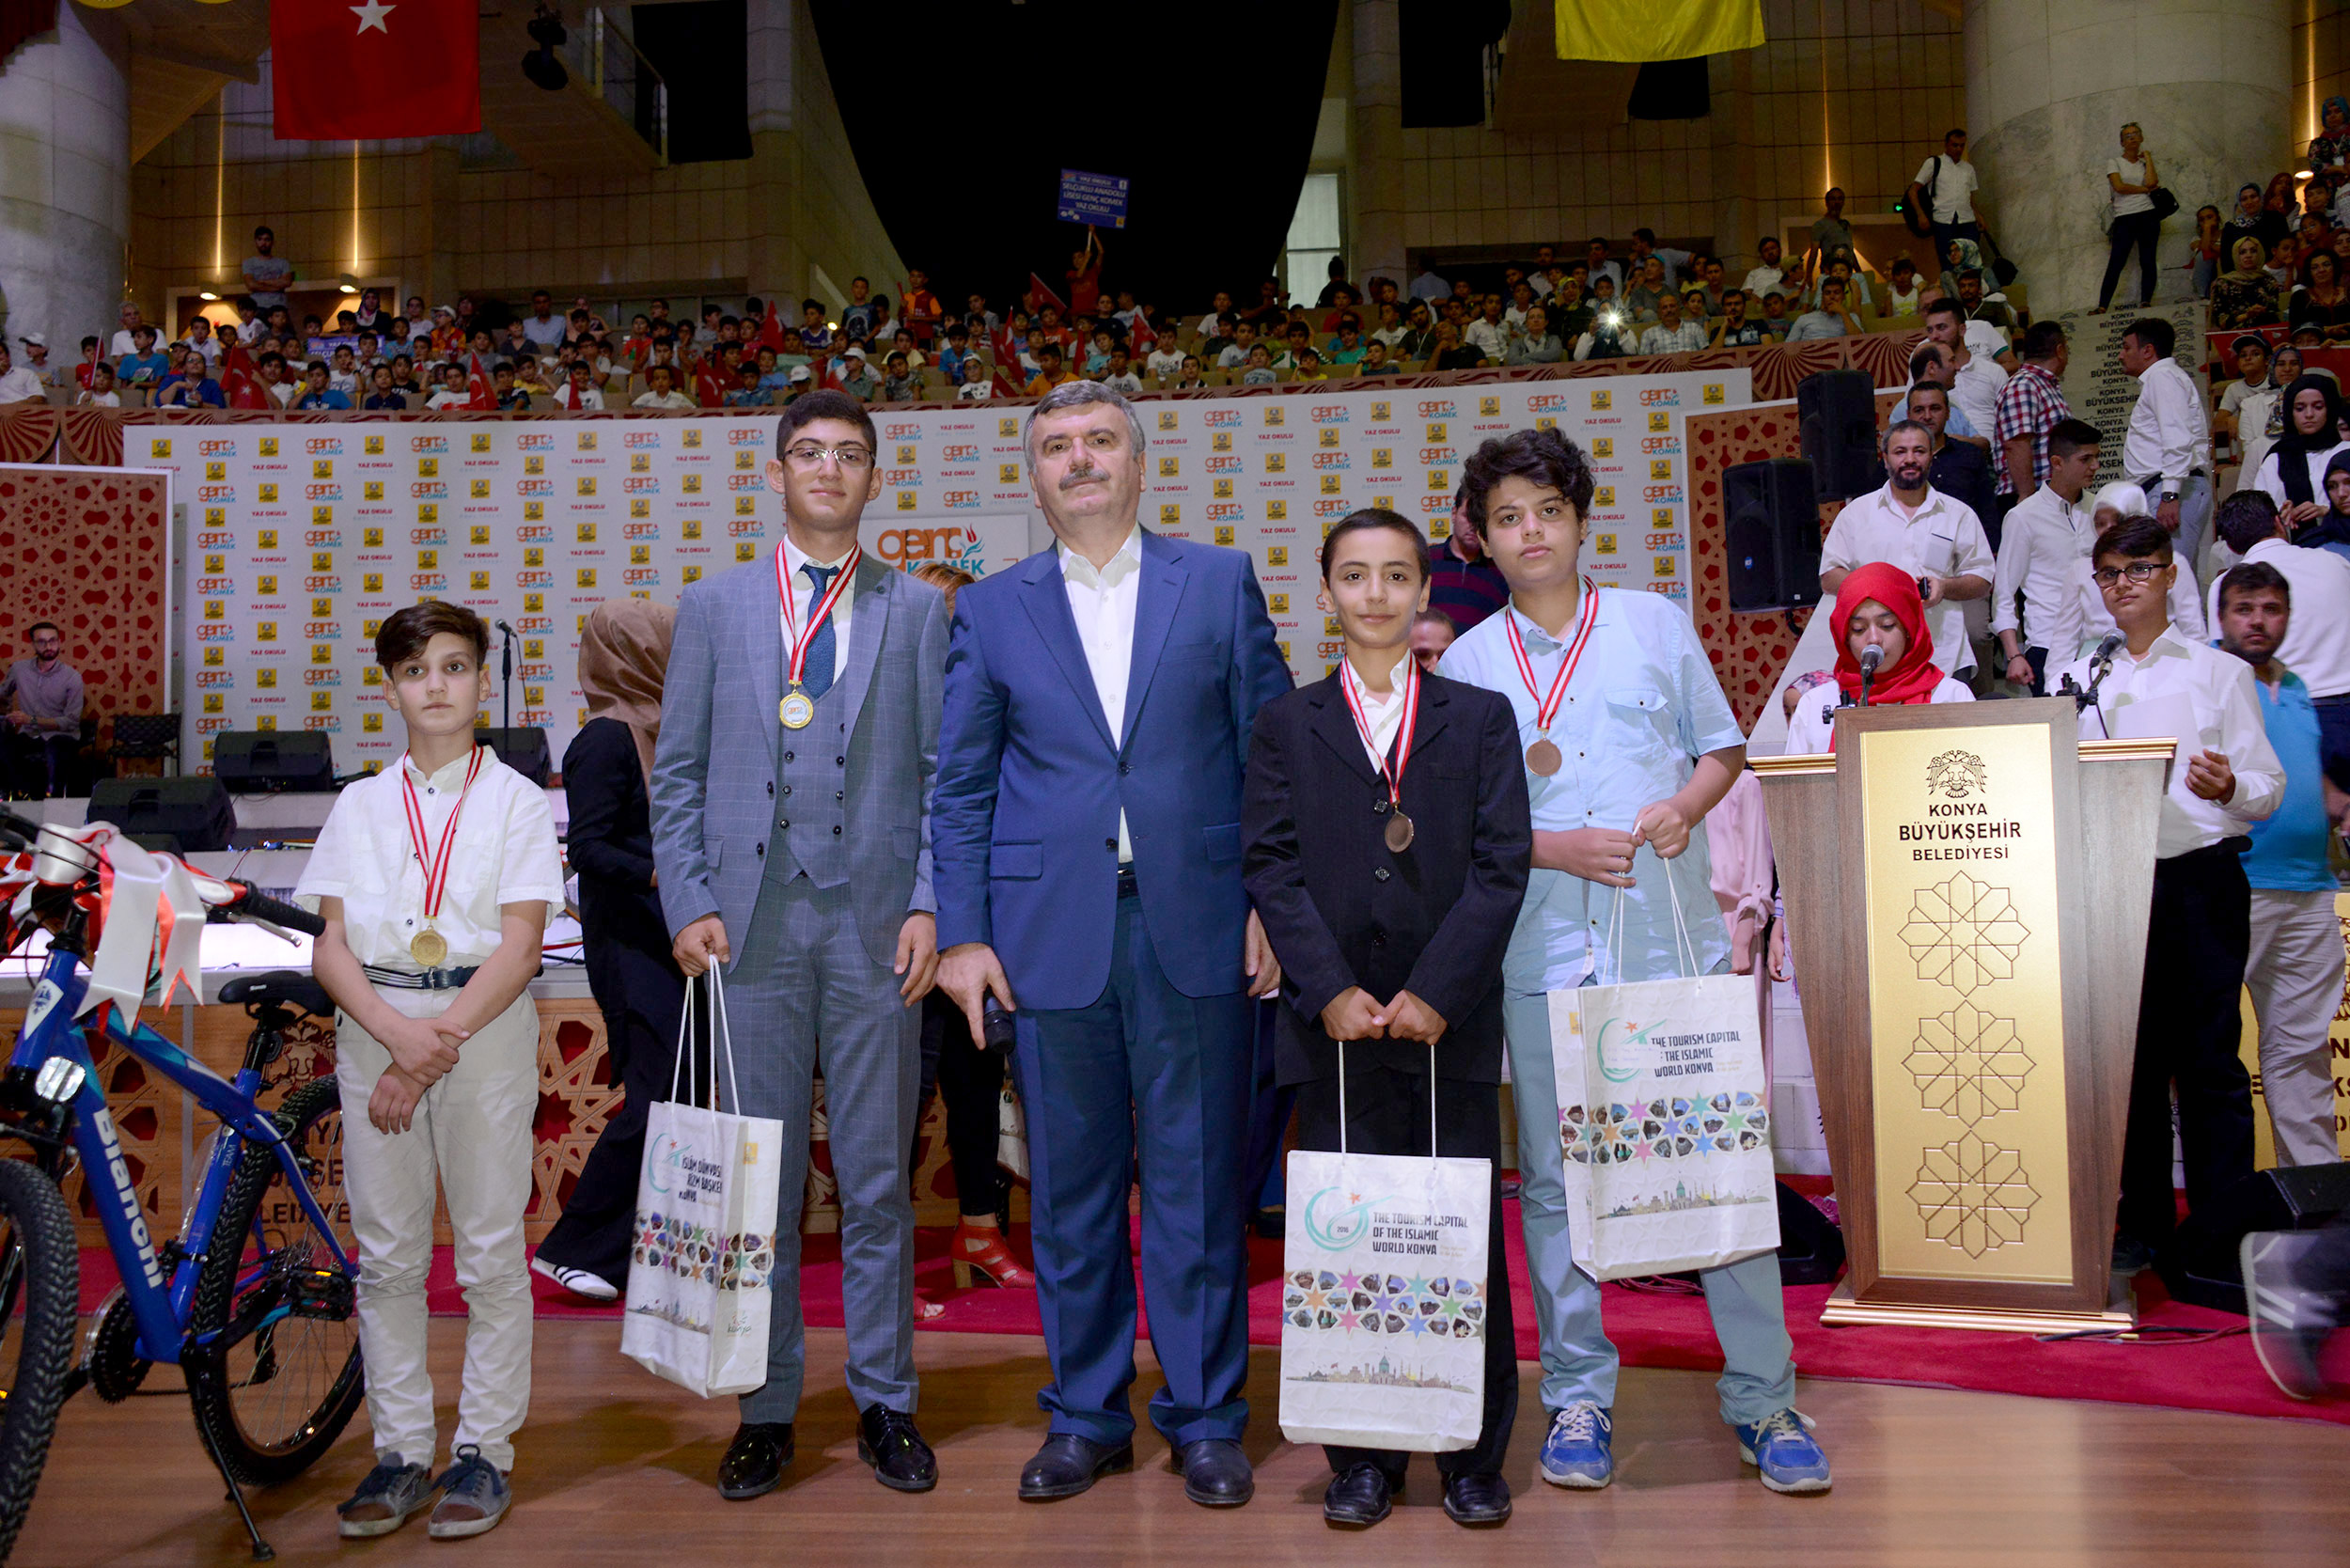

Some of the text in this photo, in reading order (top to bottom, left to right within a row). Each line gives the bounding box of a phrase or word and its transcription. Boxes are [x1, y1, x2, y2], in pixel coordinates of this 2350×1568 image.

[1094, 186, 1126, 197] ANADOLU
[1651, 399, 1681, 407] KOMEK
[1428, 411, 1457, 419] KOMEK
[2097, 406, 2124, 415] KONYA
[2094, 473, 2121, 481] ONYA
[1654, 495, 1684, 504] KOMEK
[207, 542, 236, 551] KOMEK
[1656, 543, 1685, 552] KOMEK
[907, 558, 985, 575] KMEK
[633, 578, 661, 587] KOMEK
[313, 679, 342, 687] KOMEK
[1929, 803, 1987, 816] KONYA
[1899, 818, 2021, 842] BÜYÜKŞEHİR
[1913, 844, 2009, 861] BELEDİYESİ
[1668, 1033, 1704, 1047] TOURISM
[1706, 1030, 1741, 1043] CAPITAL
[1665, 1051, 1681, 1062] THE
[1682, 1047, 1714, 1060] ISLAMIC
[1654, 1065, 1684, 1077] WORLD
[1684, 1062, 1714, 1074] KONYA
[1373, 1212, 1468, 1229] THE TOURISM CAPITAL
[1372, 1227, 1439, 1241] OF THE ISLAMIC
[1372, 1241, 1404, 1254] WORLD
[1407, 1243, 1437, 1255] KONYA
